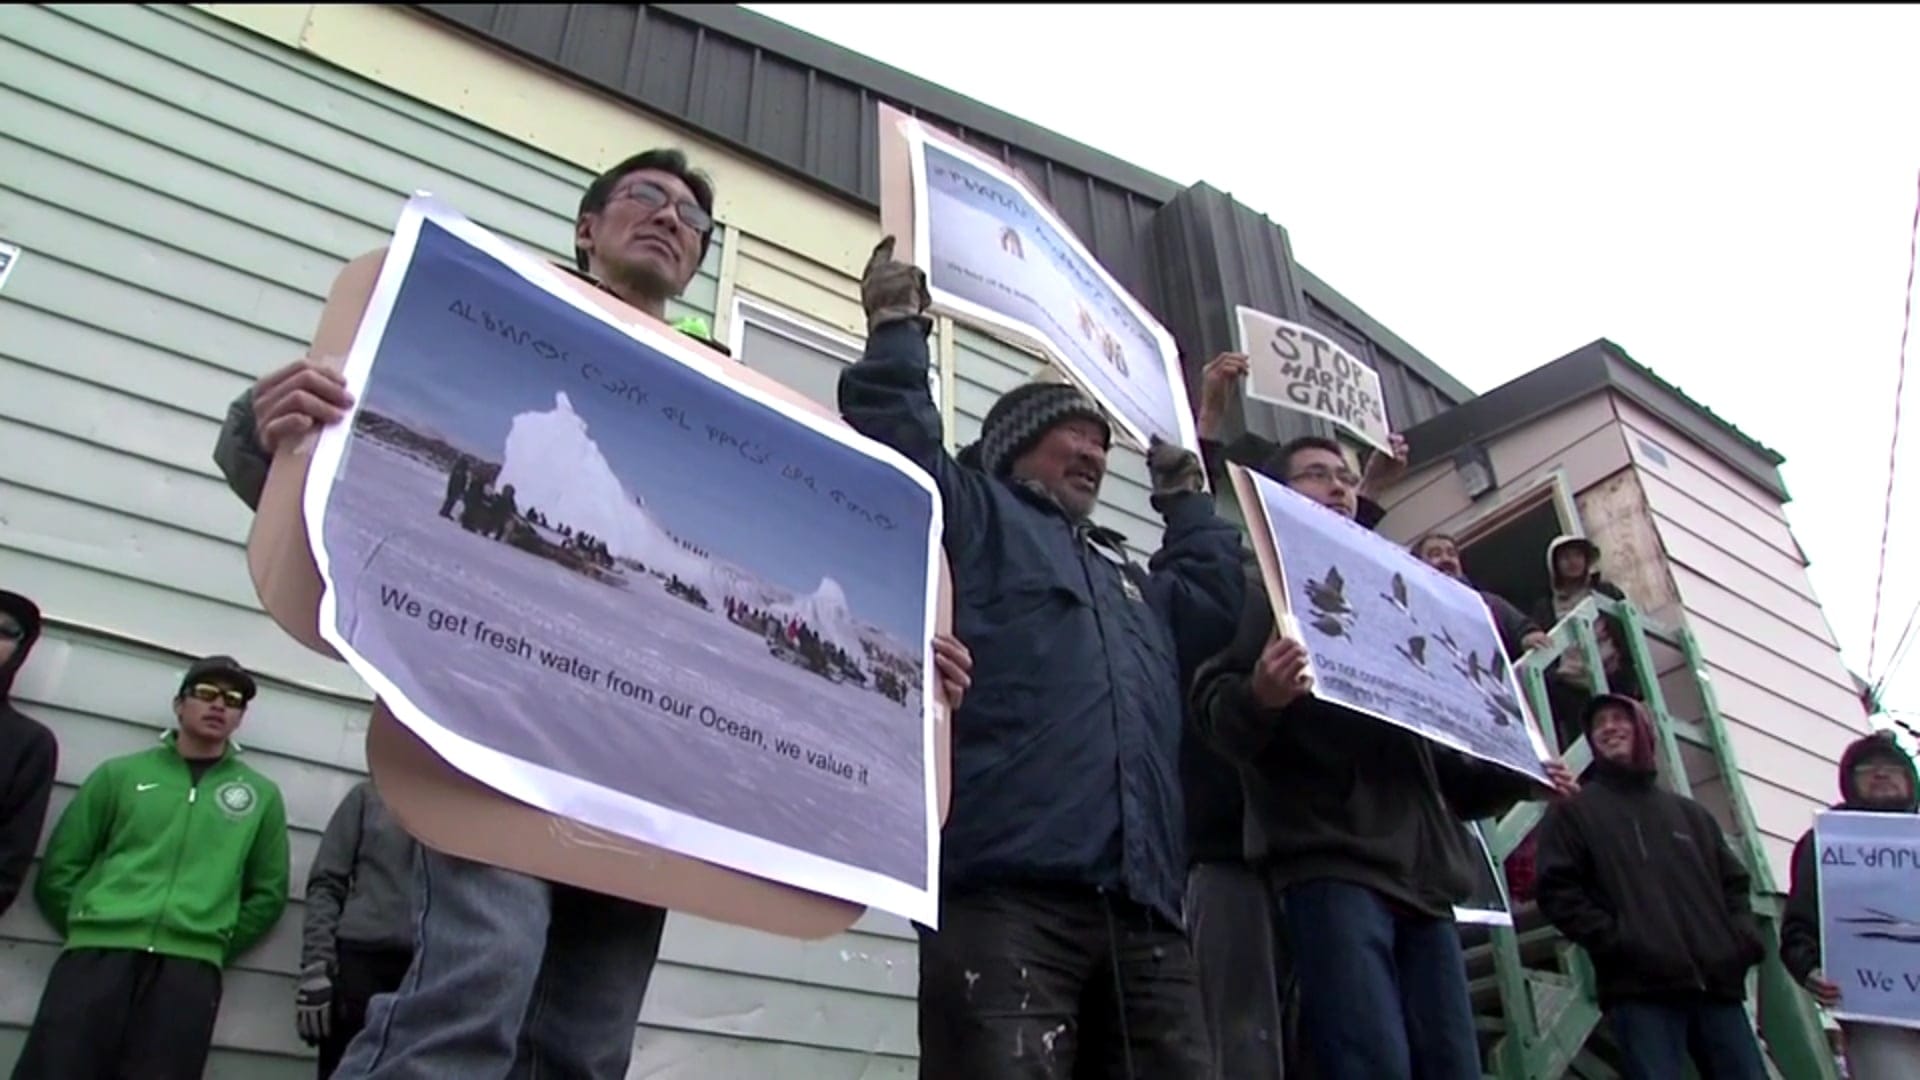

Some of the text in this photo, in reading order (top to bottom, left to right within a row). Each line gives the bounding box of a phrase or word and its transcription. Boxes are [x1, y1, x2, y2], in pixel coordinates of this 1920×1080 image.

[1271, 327, 1363, 386] STOP
[1287, 383, 1367, 431] GANG
[380, 584, 871, 787] We get fresh water from our Ocean, we value it
[1857, 968, 1894, 992] We
